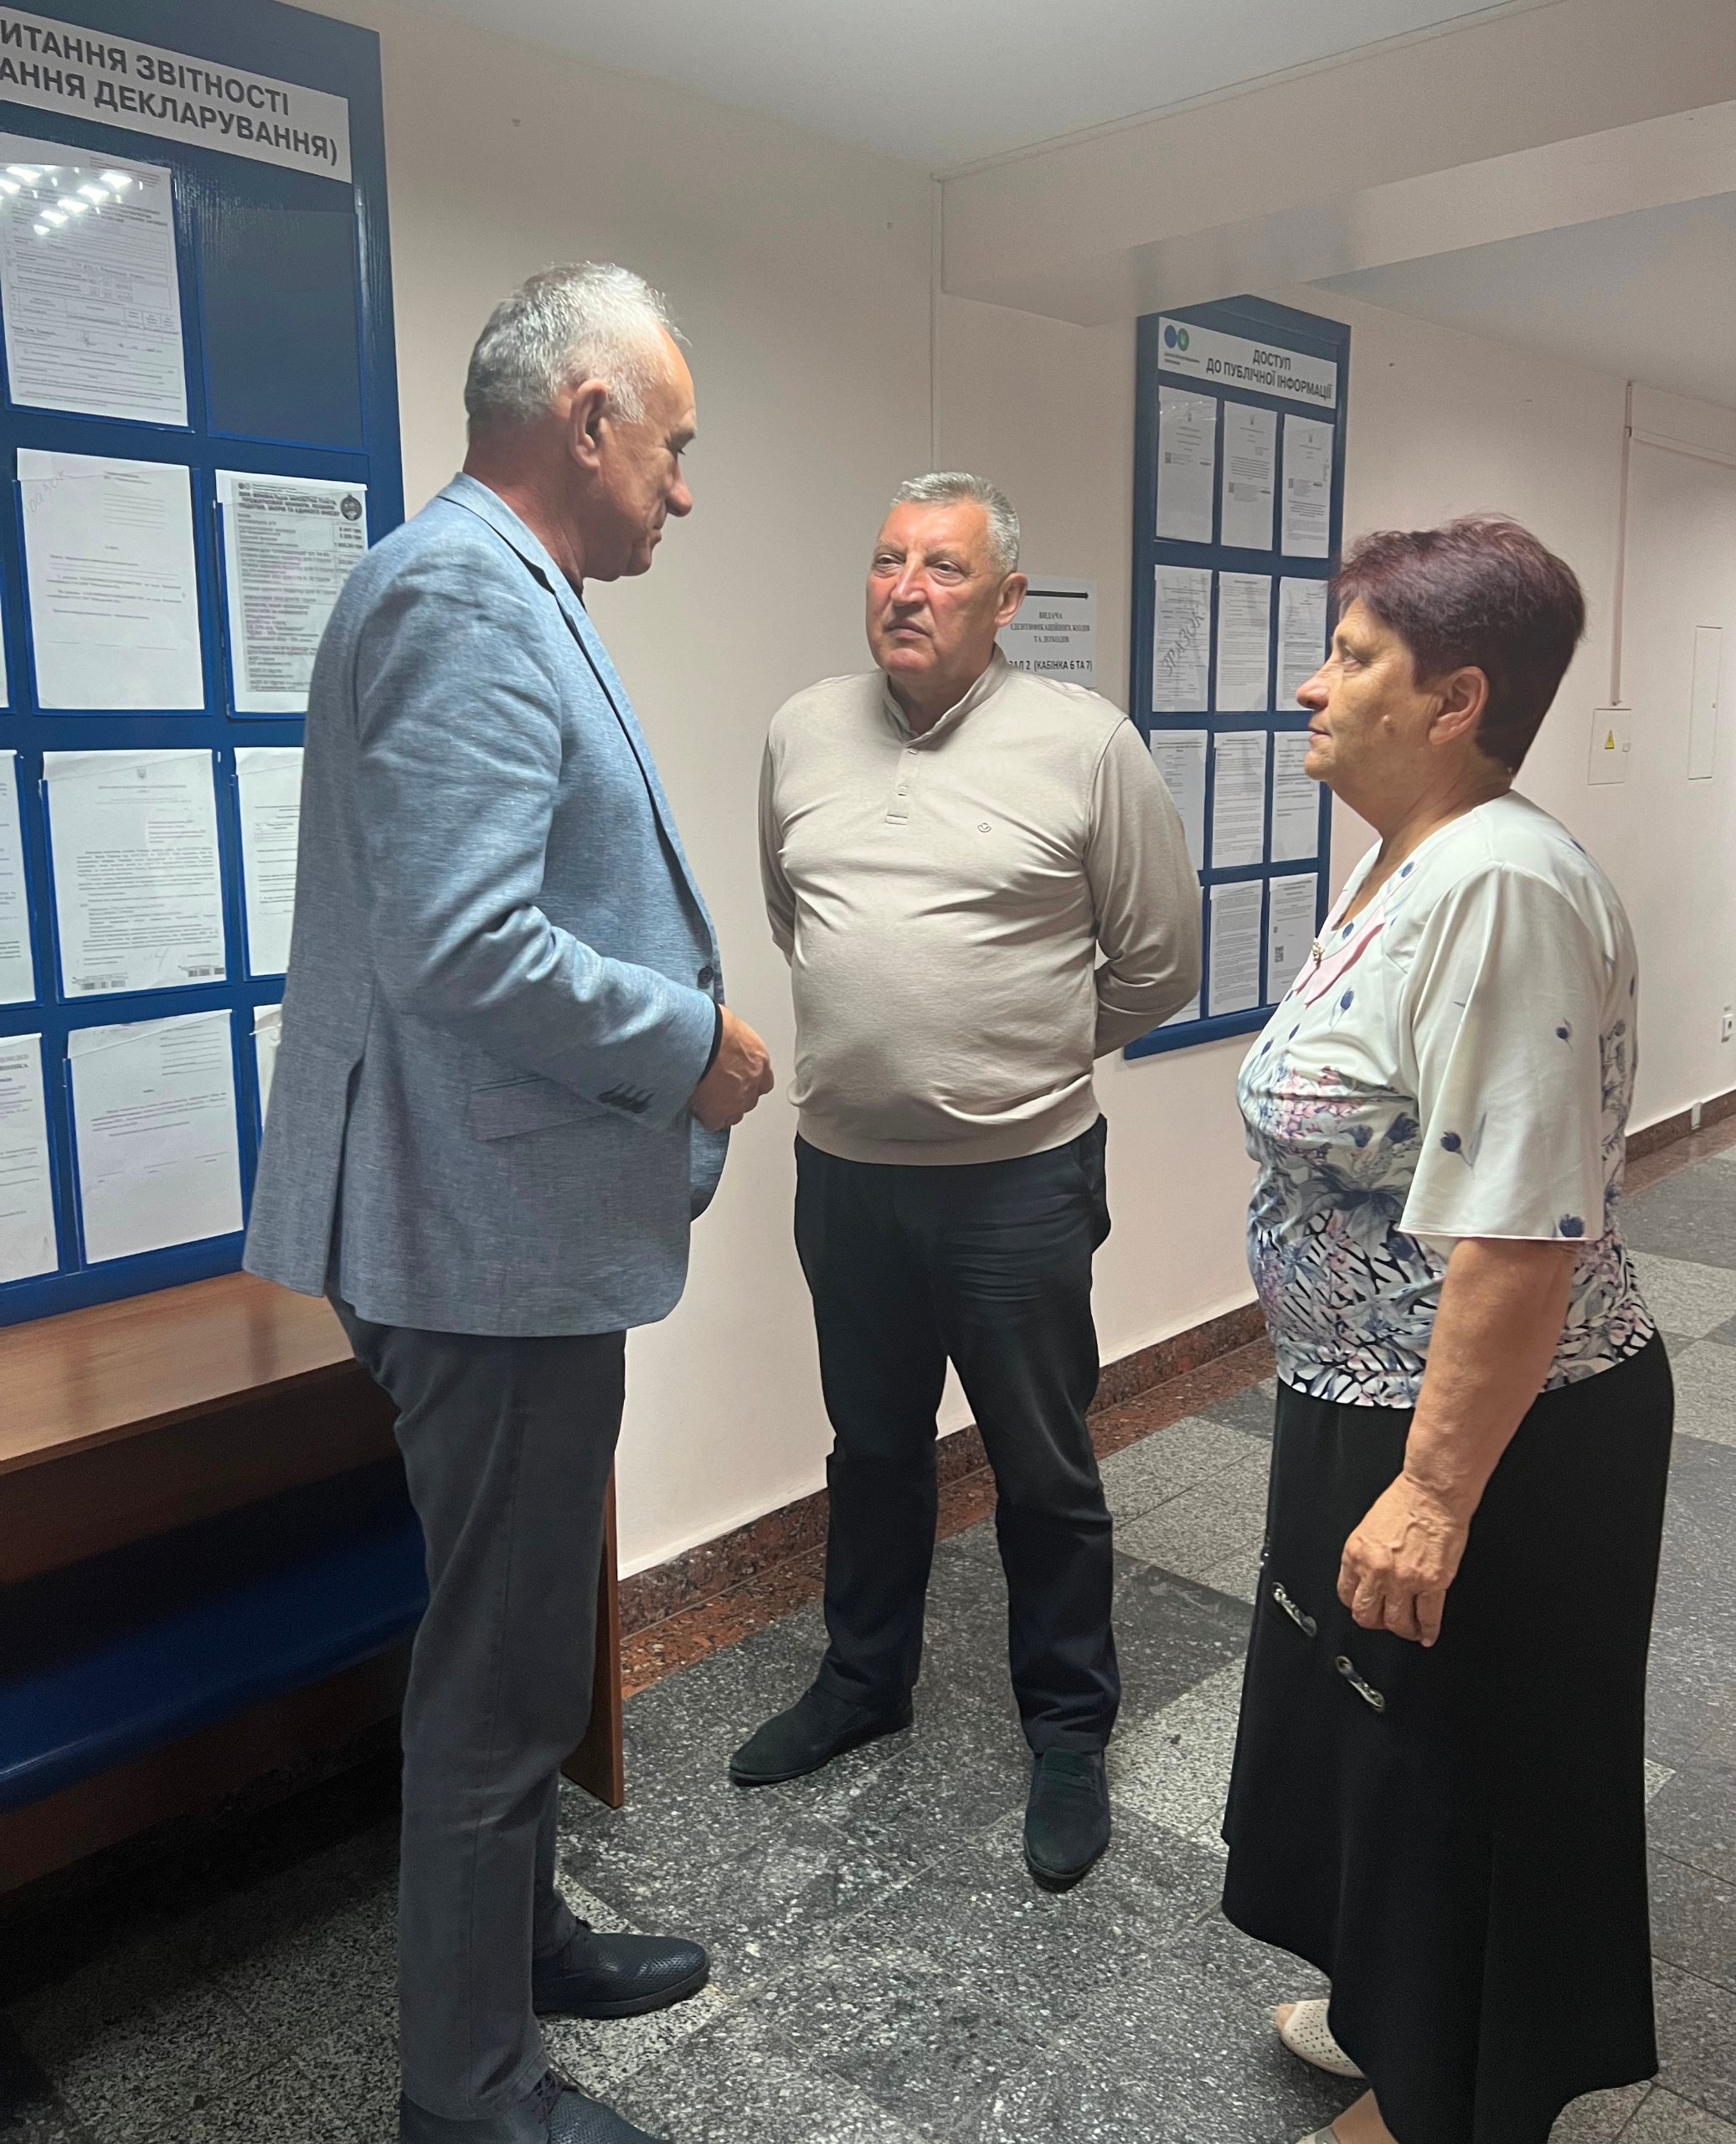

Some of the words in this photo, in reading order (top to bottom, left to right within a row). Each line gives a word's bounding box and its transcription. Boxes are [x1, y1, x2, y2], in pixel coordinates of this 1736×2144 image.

[0, 19, 127, 75] ИТАННЯ
[136, 54, 290, 116] ЗВІТНОСТІ
[0, 57, 85, 100] АННЯ
[94, 80, 337, 167] ДЕКЛАРУВАННЯ)
[1206, 357, 1222, 375] ДО
[1223, 362, 1276, 387] ПУБЛІЧНОЇ
[1277, 374, 1333, 401] ІНФОРМАЦІЇ
[1253, 348, 1291, 371] ДОСТУП
[1026, 660, 1031, 670] 2
[1033, 659, 1069, 673] (КАБІНКА
[1069, 660, 1075, 670] 6
[1075, 660, 1084, 670] ТА
[1085, 659, 1093, 672] 7)
